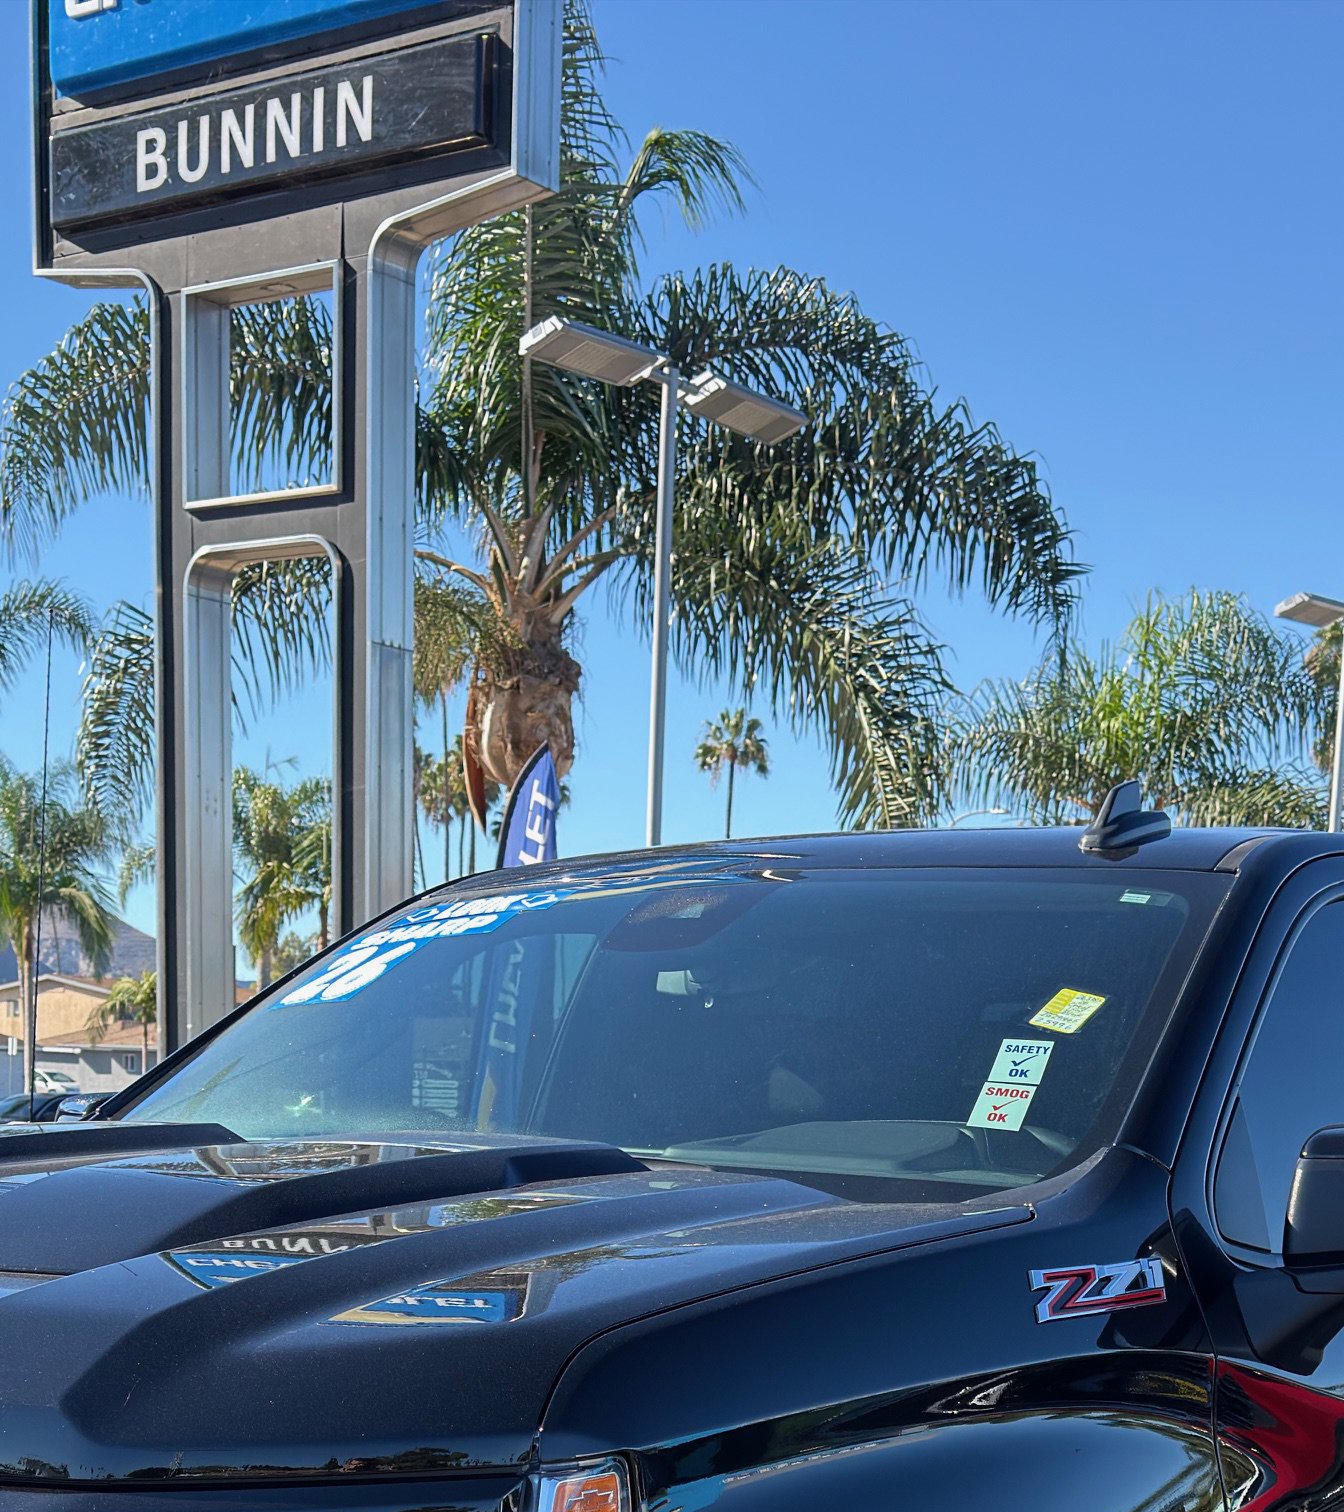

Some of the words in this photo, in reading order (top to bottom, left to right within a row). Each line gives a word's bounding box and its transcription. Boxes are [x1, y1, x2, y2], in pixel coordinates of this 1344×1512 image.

[136, 75, 373, 193] BUNNIN
[433, 894, 528, 920] LOOK
[351, 914, 498, 950] SHARP
[1005, 1044, 1050, 1055] SAFETY
[1008, 1068, 1030, 1078] OK
[985, 1087, 1030, 1099] SMOG
[986, 1112, 1008, 1122] OK
[1027, 1257, 1167, 1324] Z71
